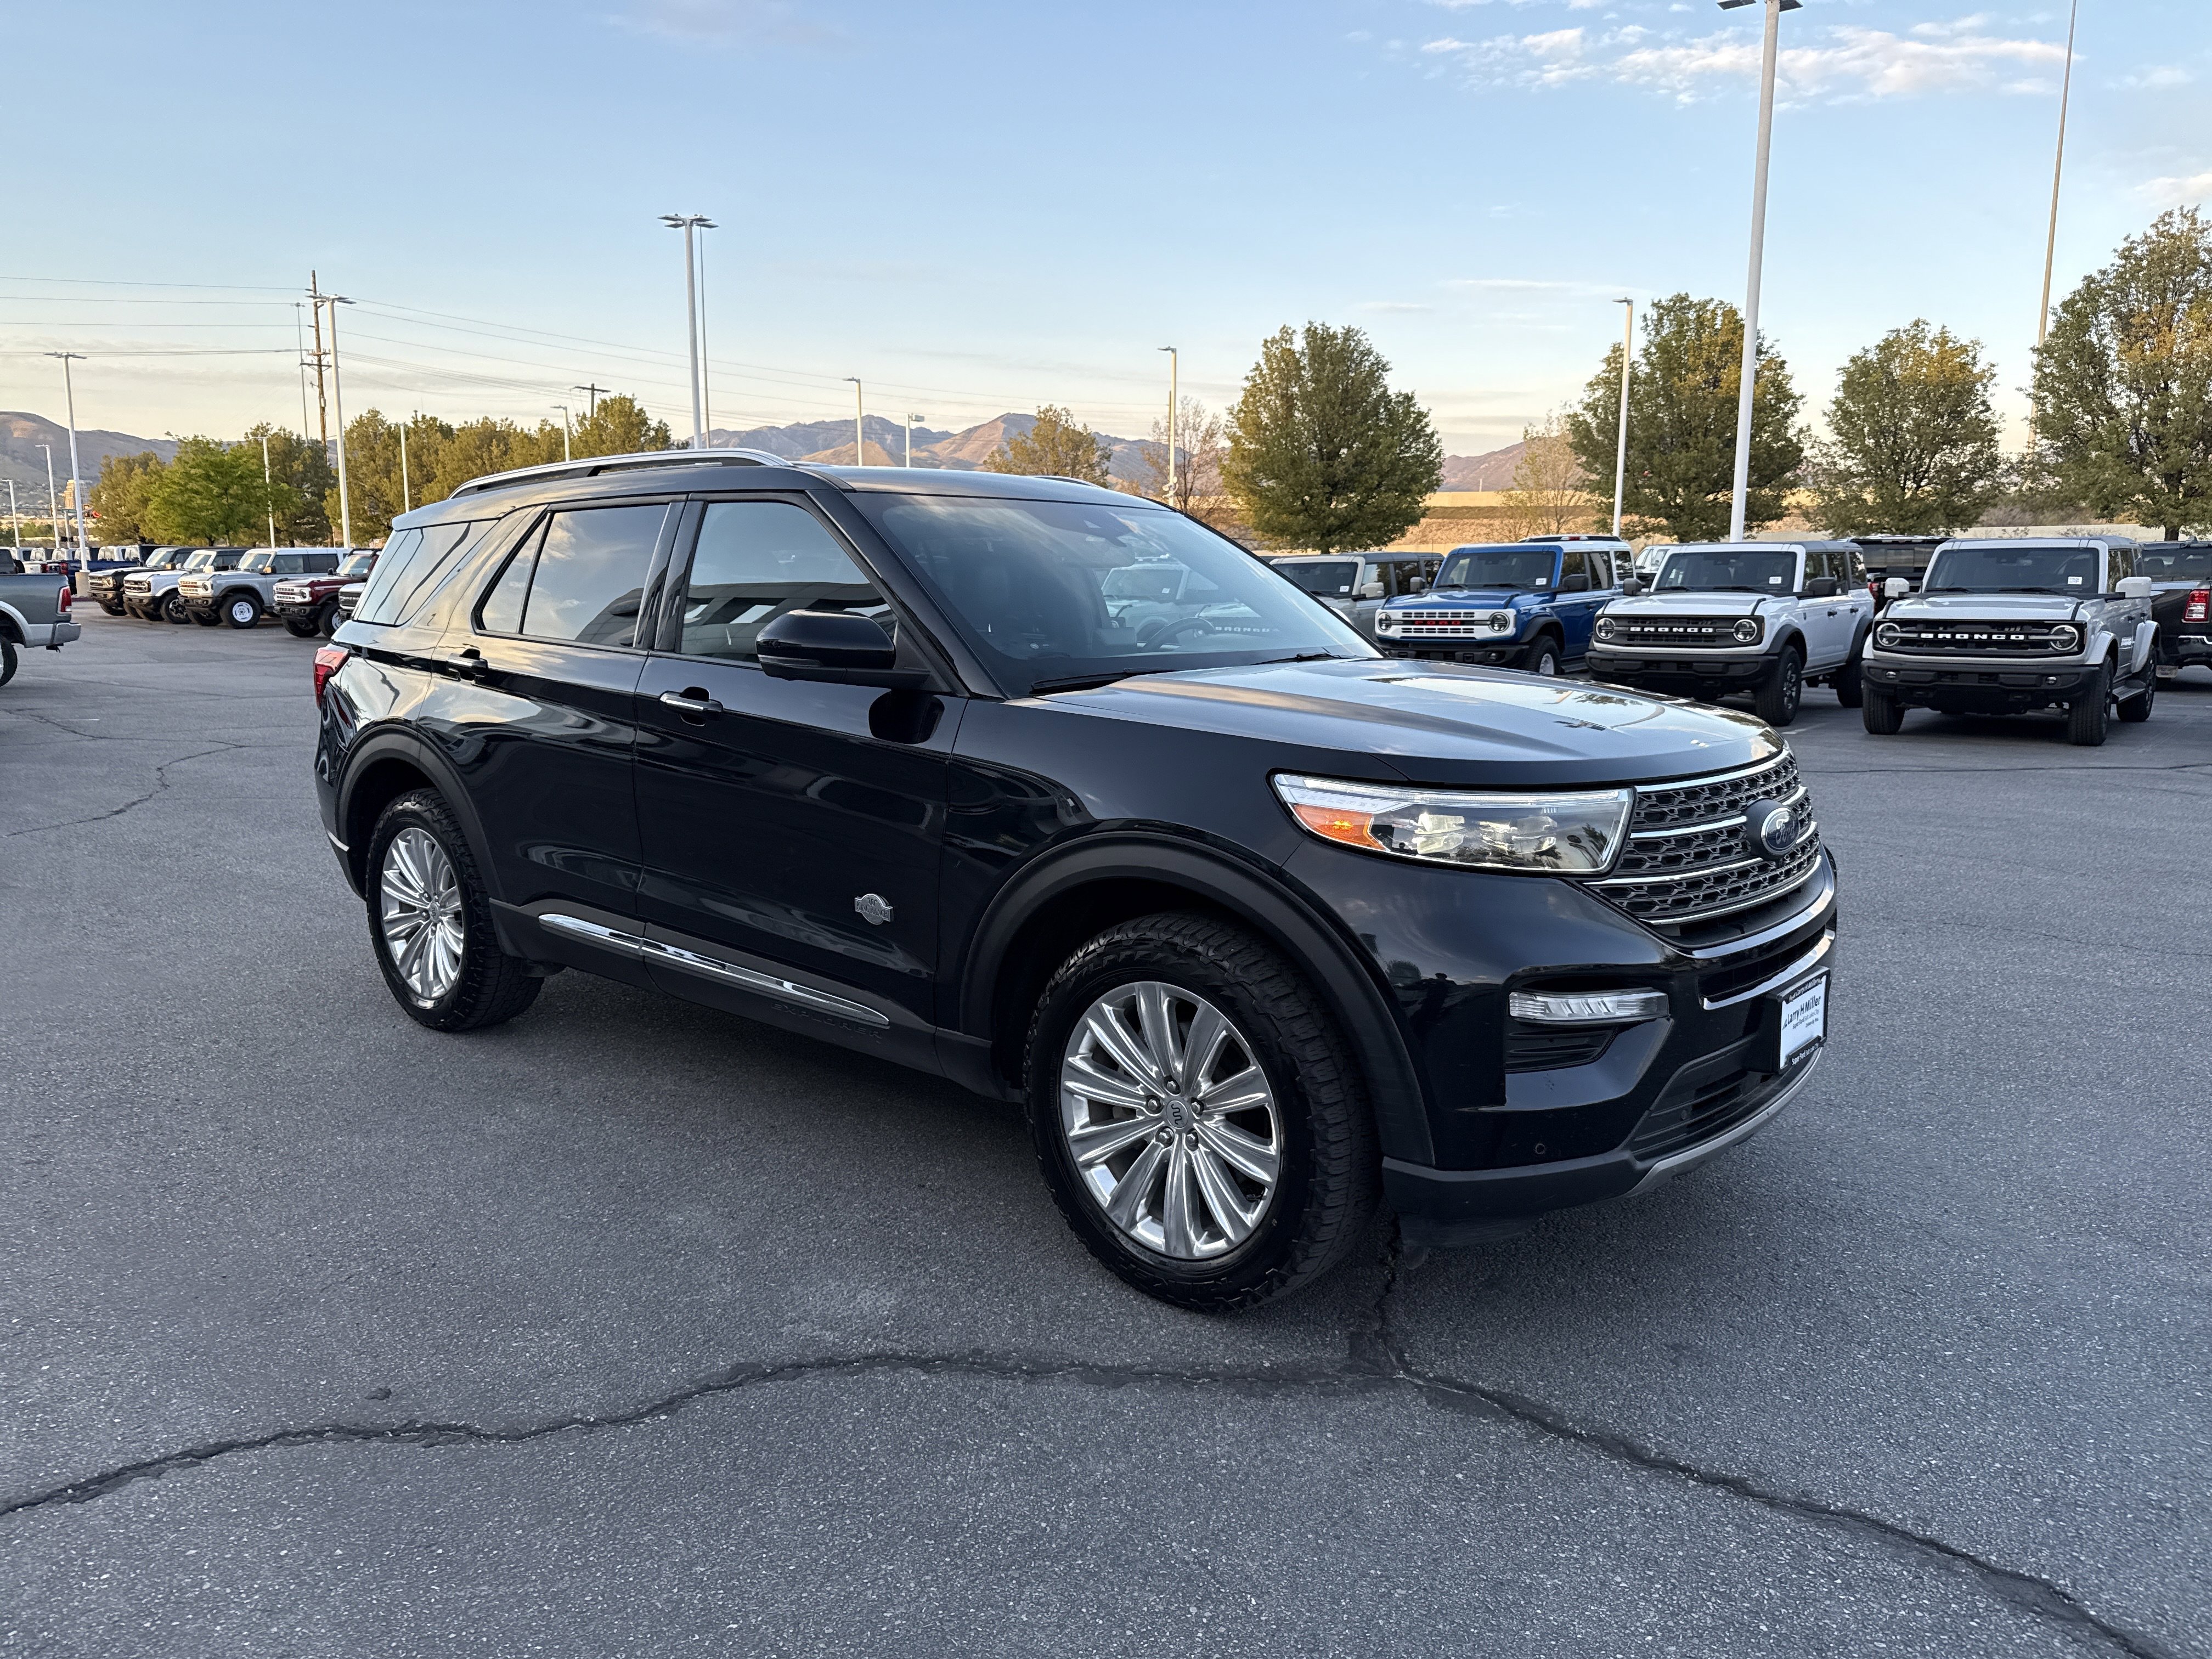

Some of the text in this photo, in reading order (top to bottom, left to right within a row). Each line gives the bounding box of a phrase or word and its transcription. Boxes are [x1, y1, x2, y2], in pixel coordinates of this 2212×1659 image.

[1299, 794, 1379, 809] EXPLORER
[1775, 817, 1796, 844] Ford
[856, 901, 889, 918] KING RANCH
[771, 1003, 882, 1040] EXPLORER
[1787, 995, 1821, 1025] Larry H Miller
